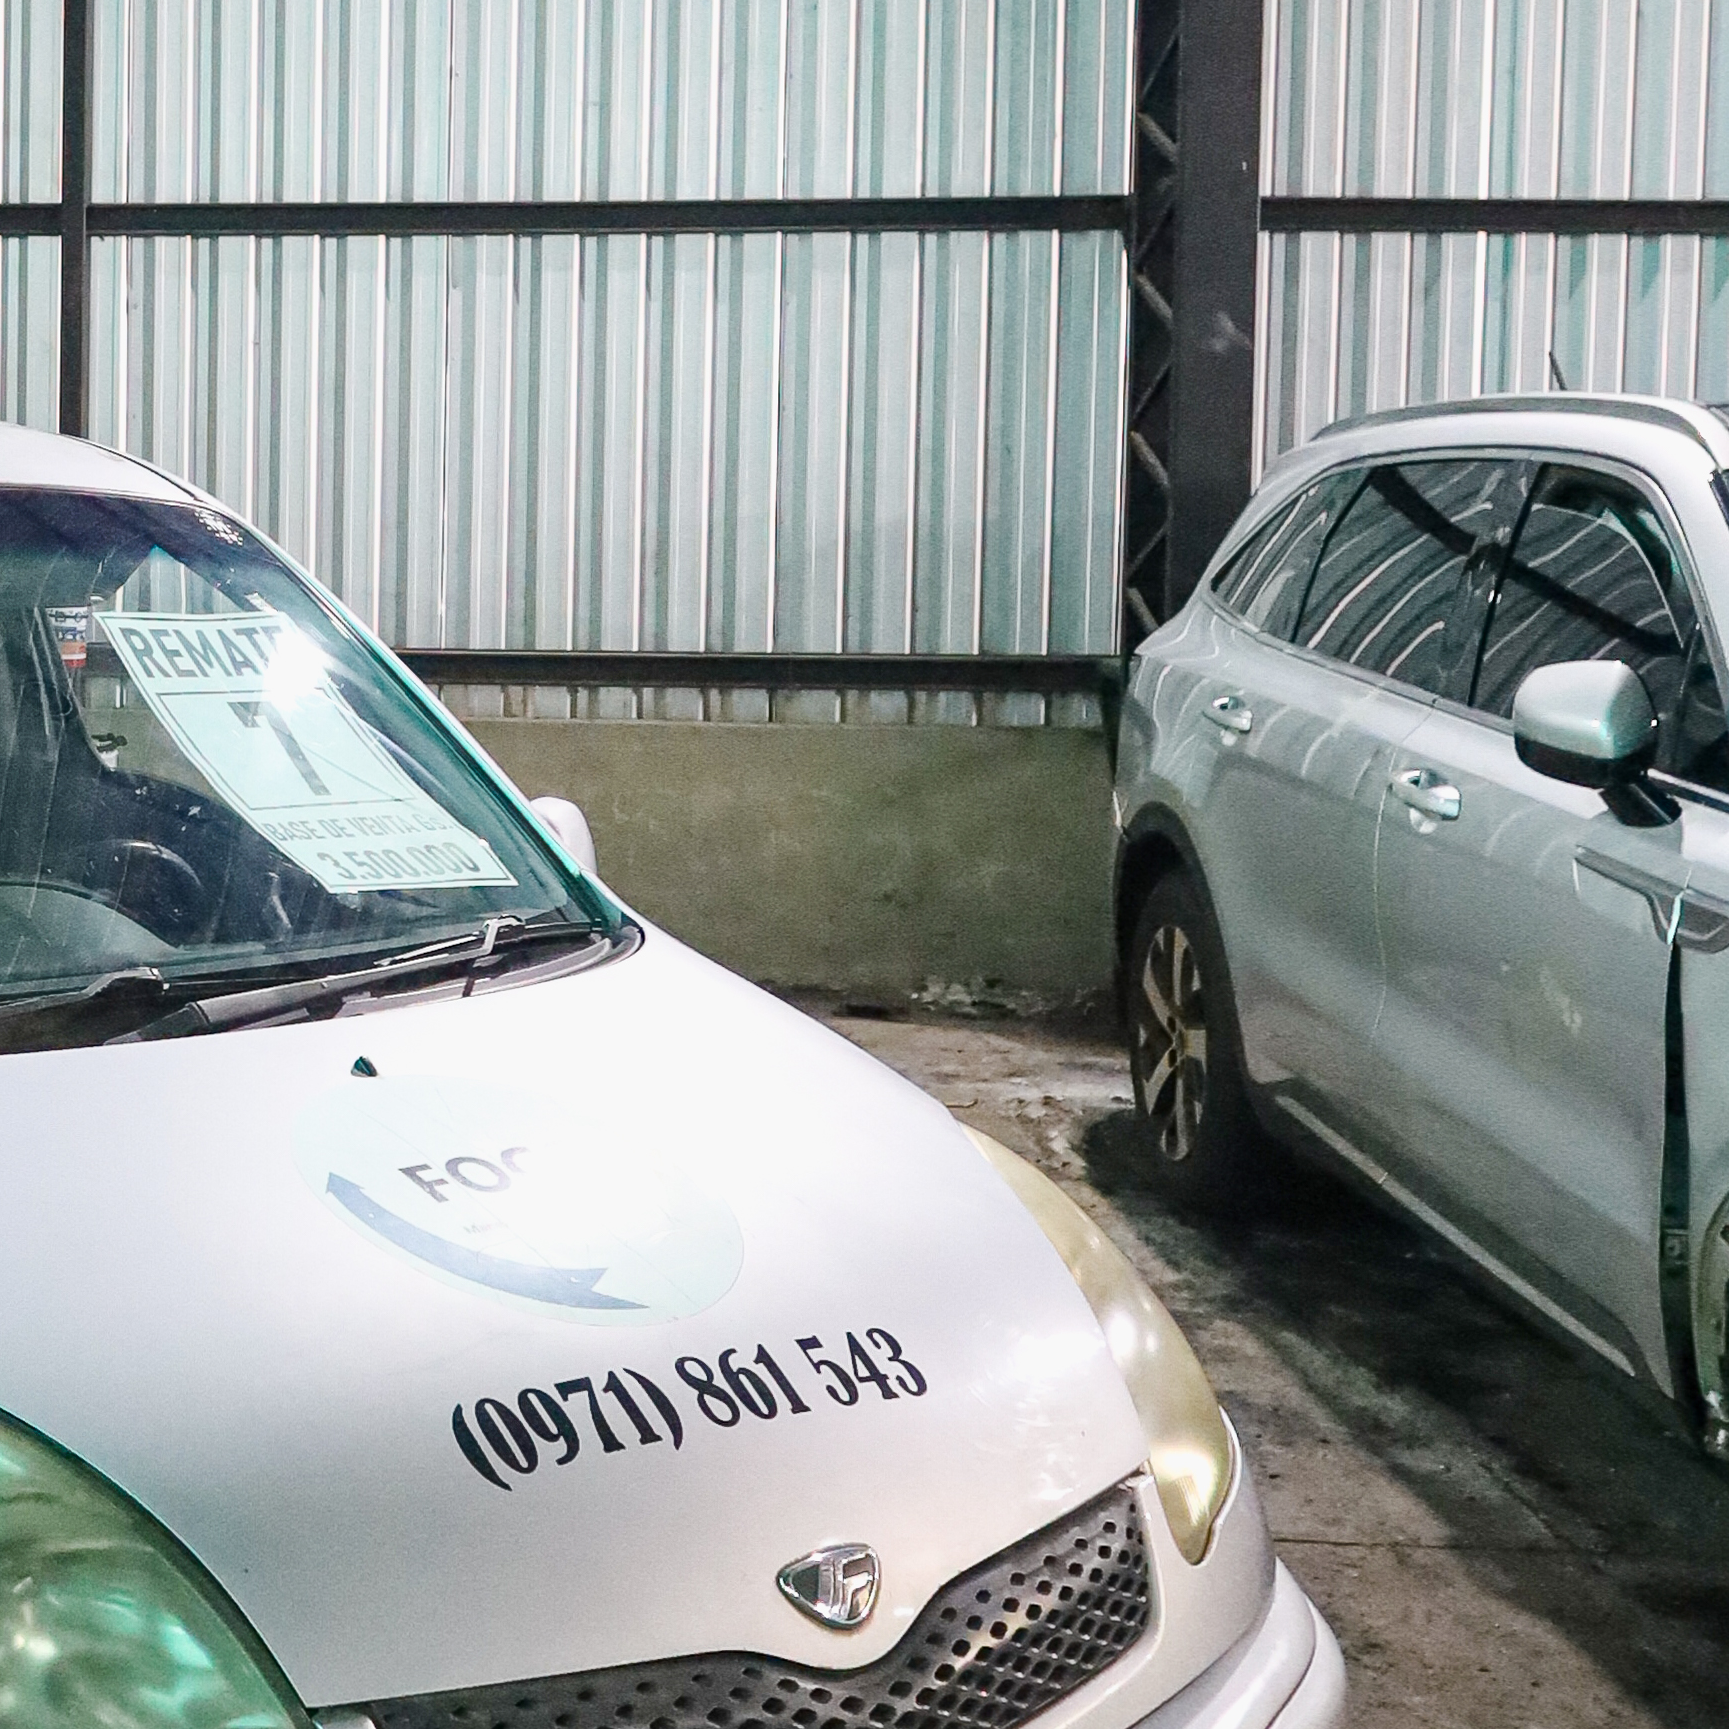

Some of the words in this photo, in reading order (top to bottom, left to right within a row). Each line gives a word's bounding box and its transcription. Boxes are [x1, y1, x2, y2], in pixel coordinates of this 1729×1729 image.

[226, 700, 332, 796] 7
[270, 820, 326, 841] BASE
[321, 818, 351, 839] DE
[353, 814, 419, 837] VENTA
[316, 841, 481, 881] 3.500.000
[397, 1146, 530, 1203] FO
[451, 1367, 684, 1492] (0971)
[673, 1343, 812, 1429] 861
[794, 1327, 929, 1407] 543
